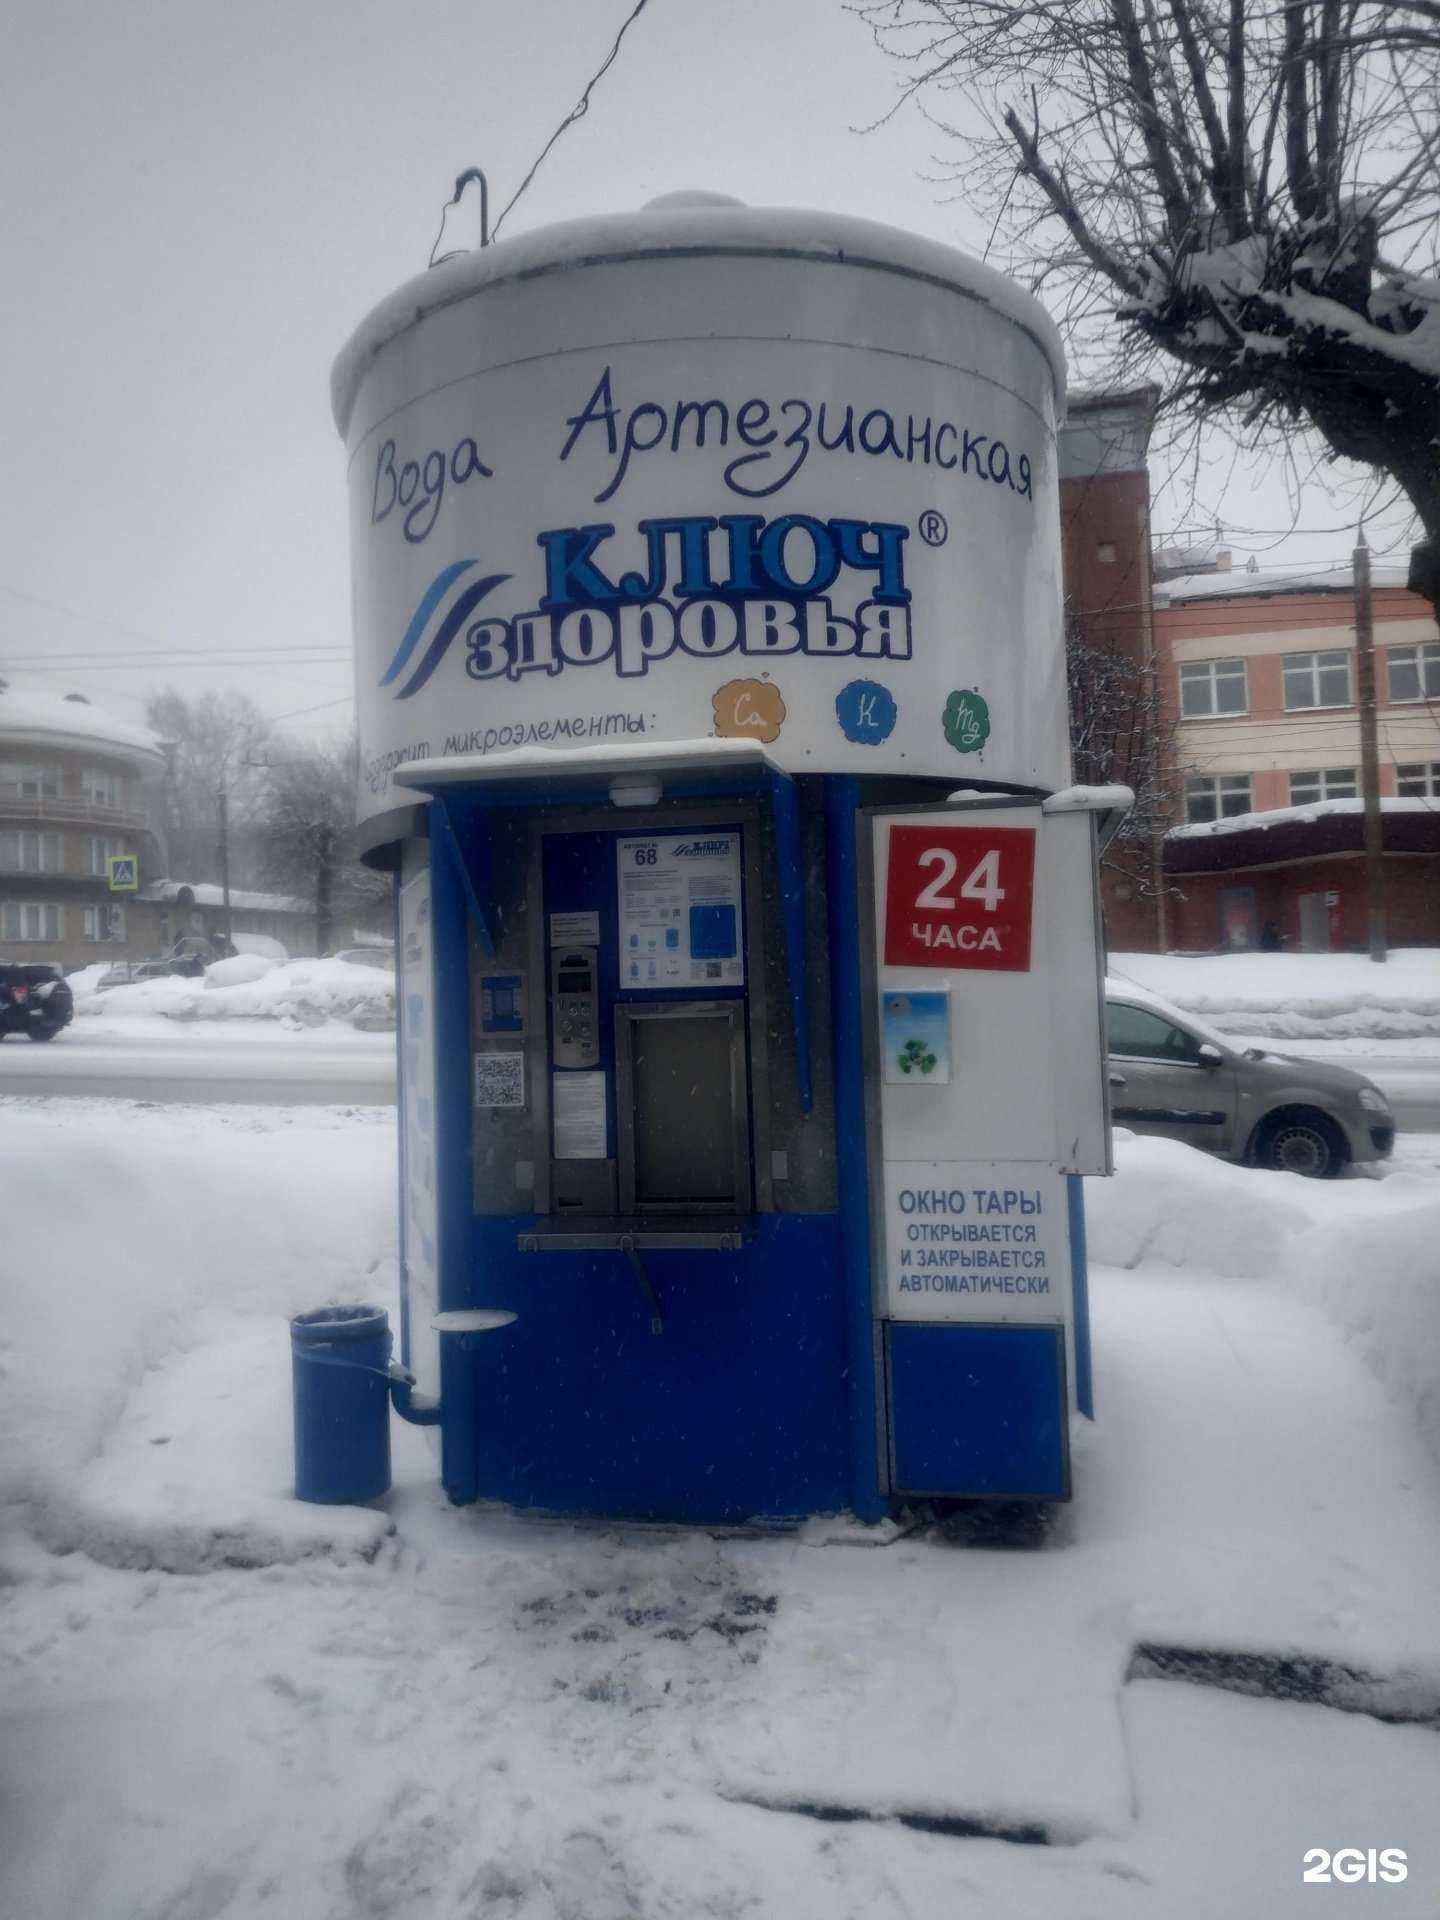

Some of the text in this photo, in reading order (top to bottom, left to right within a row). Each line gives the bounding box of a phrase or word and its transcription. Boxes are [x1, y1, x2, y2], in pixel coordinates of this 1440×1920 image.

[372, 366, 1034, 543] Вода Артезианская
[443, 711, 657, 756] микроэлементы:
[635, 848, 658, 866] 68
[914, 847, 1006, 912] 24
[911, 924, 1003, 952] ЧАСА
[898, 1189, 1042, 1216] ОКНО ТАРЫ
[906, 1223, 1037, 1244] ОТКРЫВАЕТСЯ
[900, 1248, 1046, 1269] И ЗАКРЫВАЕТСЯ
[898, 1273, 1050, 1295] АВТОМАТИЧЕСКИ
